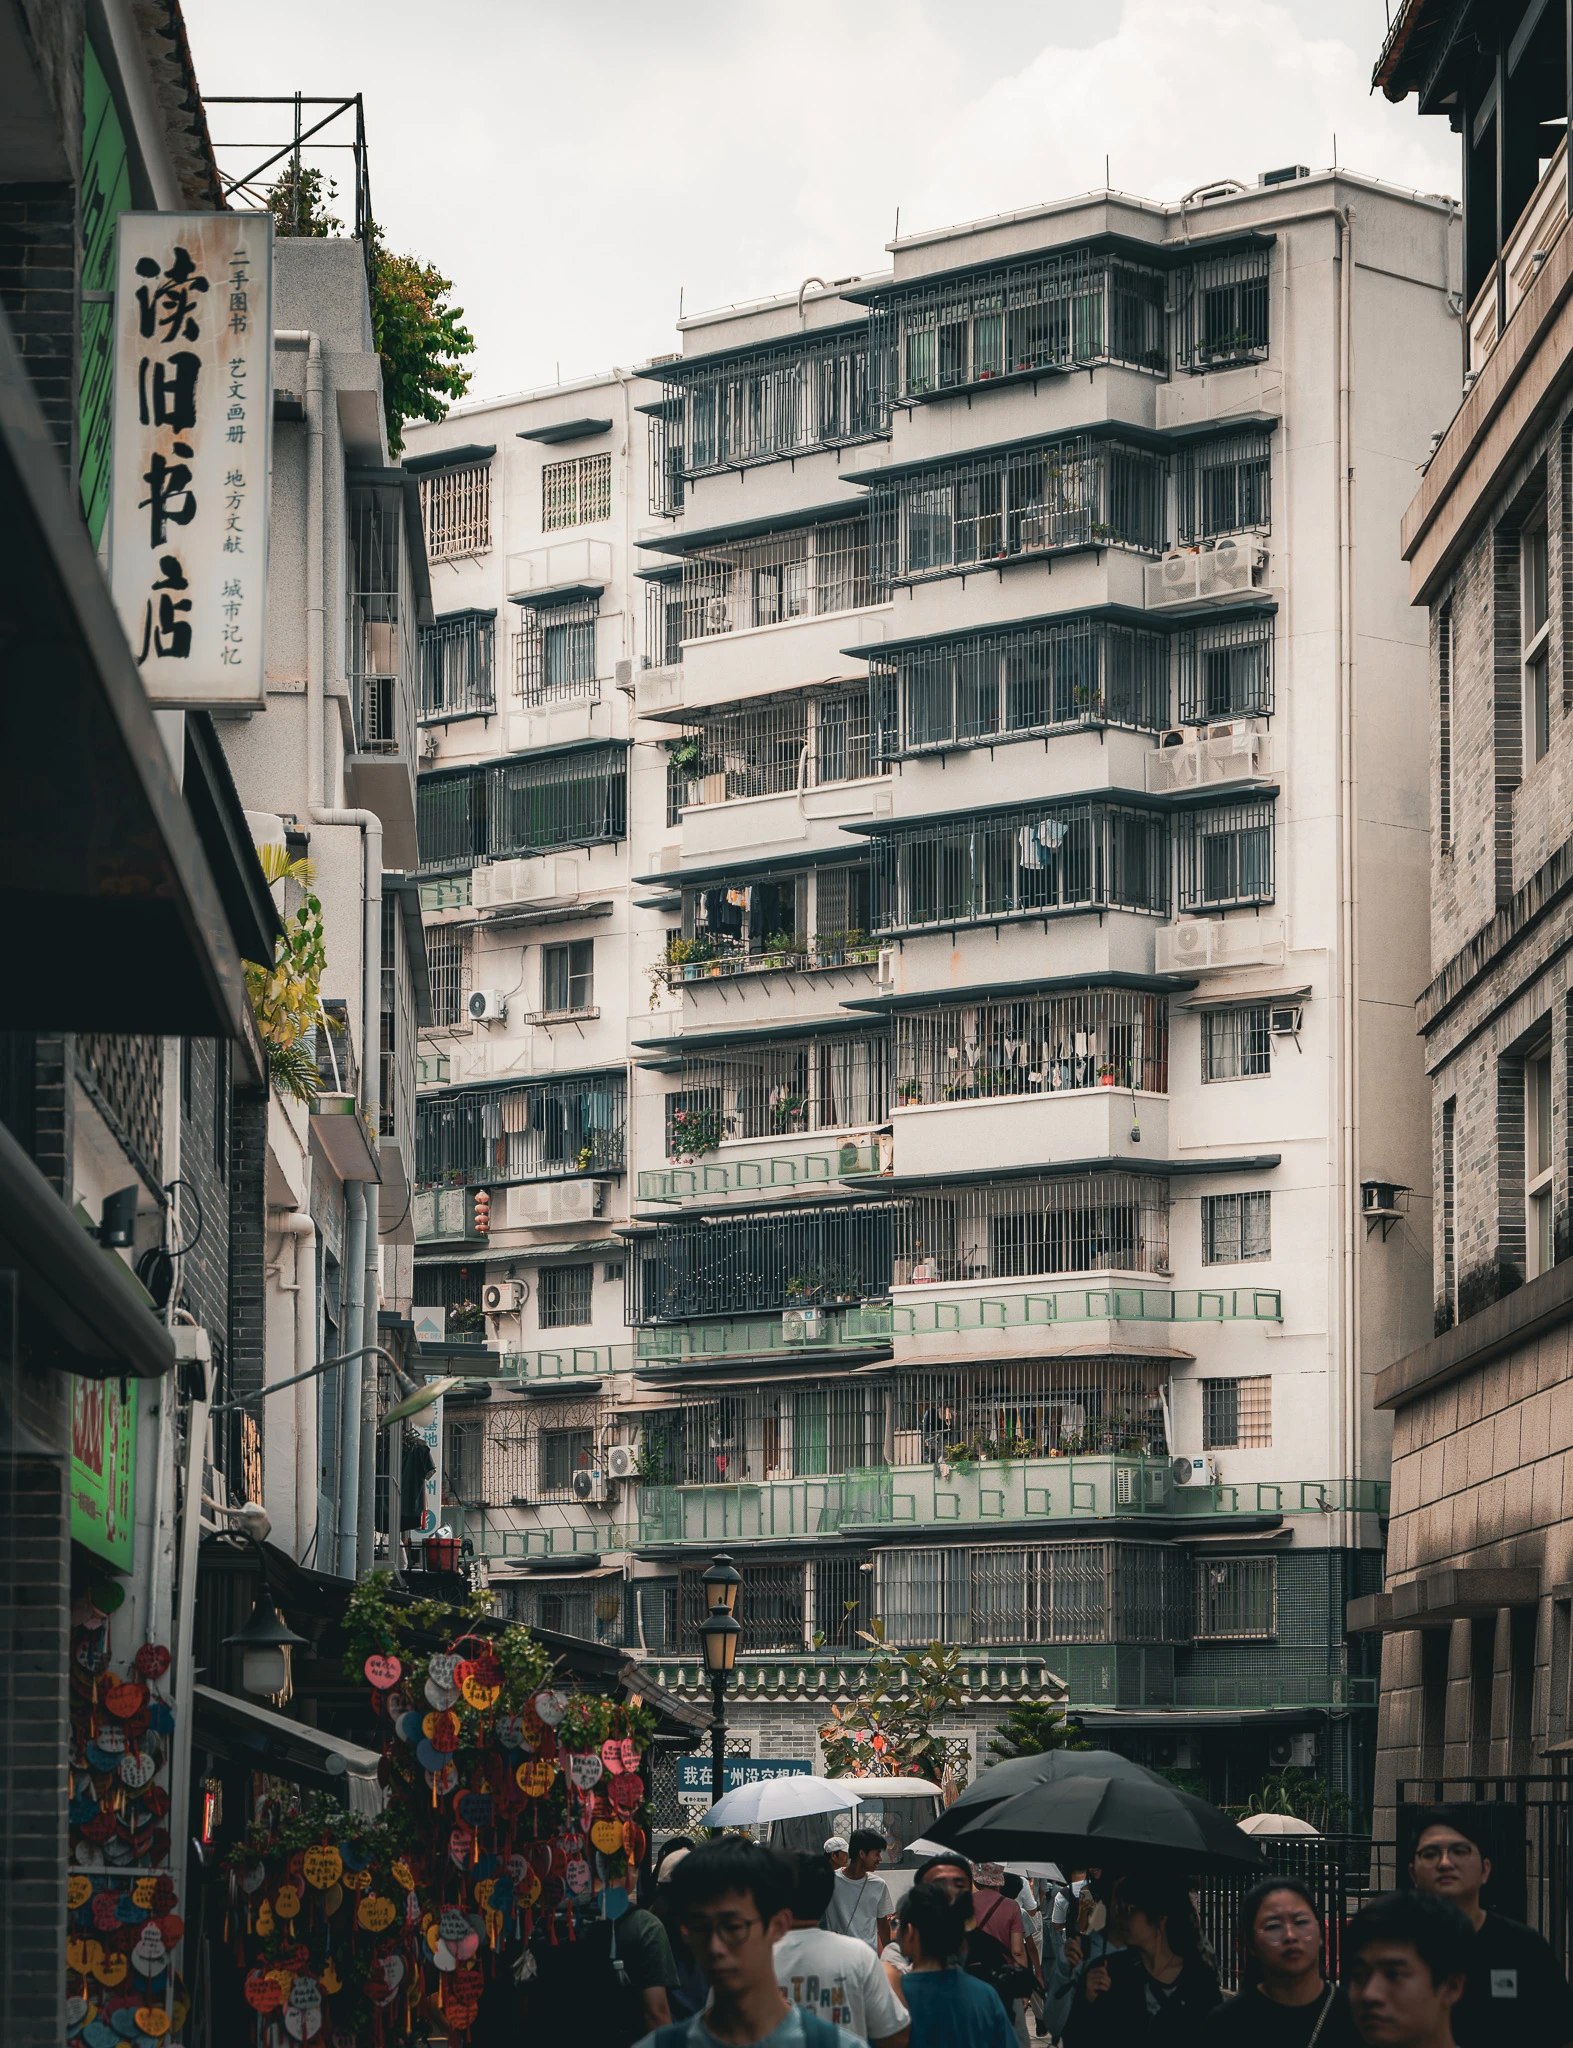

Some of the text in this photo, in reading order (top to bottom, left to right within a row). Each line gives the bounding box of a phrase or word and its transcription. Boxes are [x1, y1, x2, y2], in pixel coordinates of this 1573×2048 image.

[220, 252, 250, 665] 二手图书 艺文画册 地方文献 城市记忆
[683, 1765, 806, 1787] 我在州没空想
